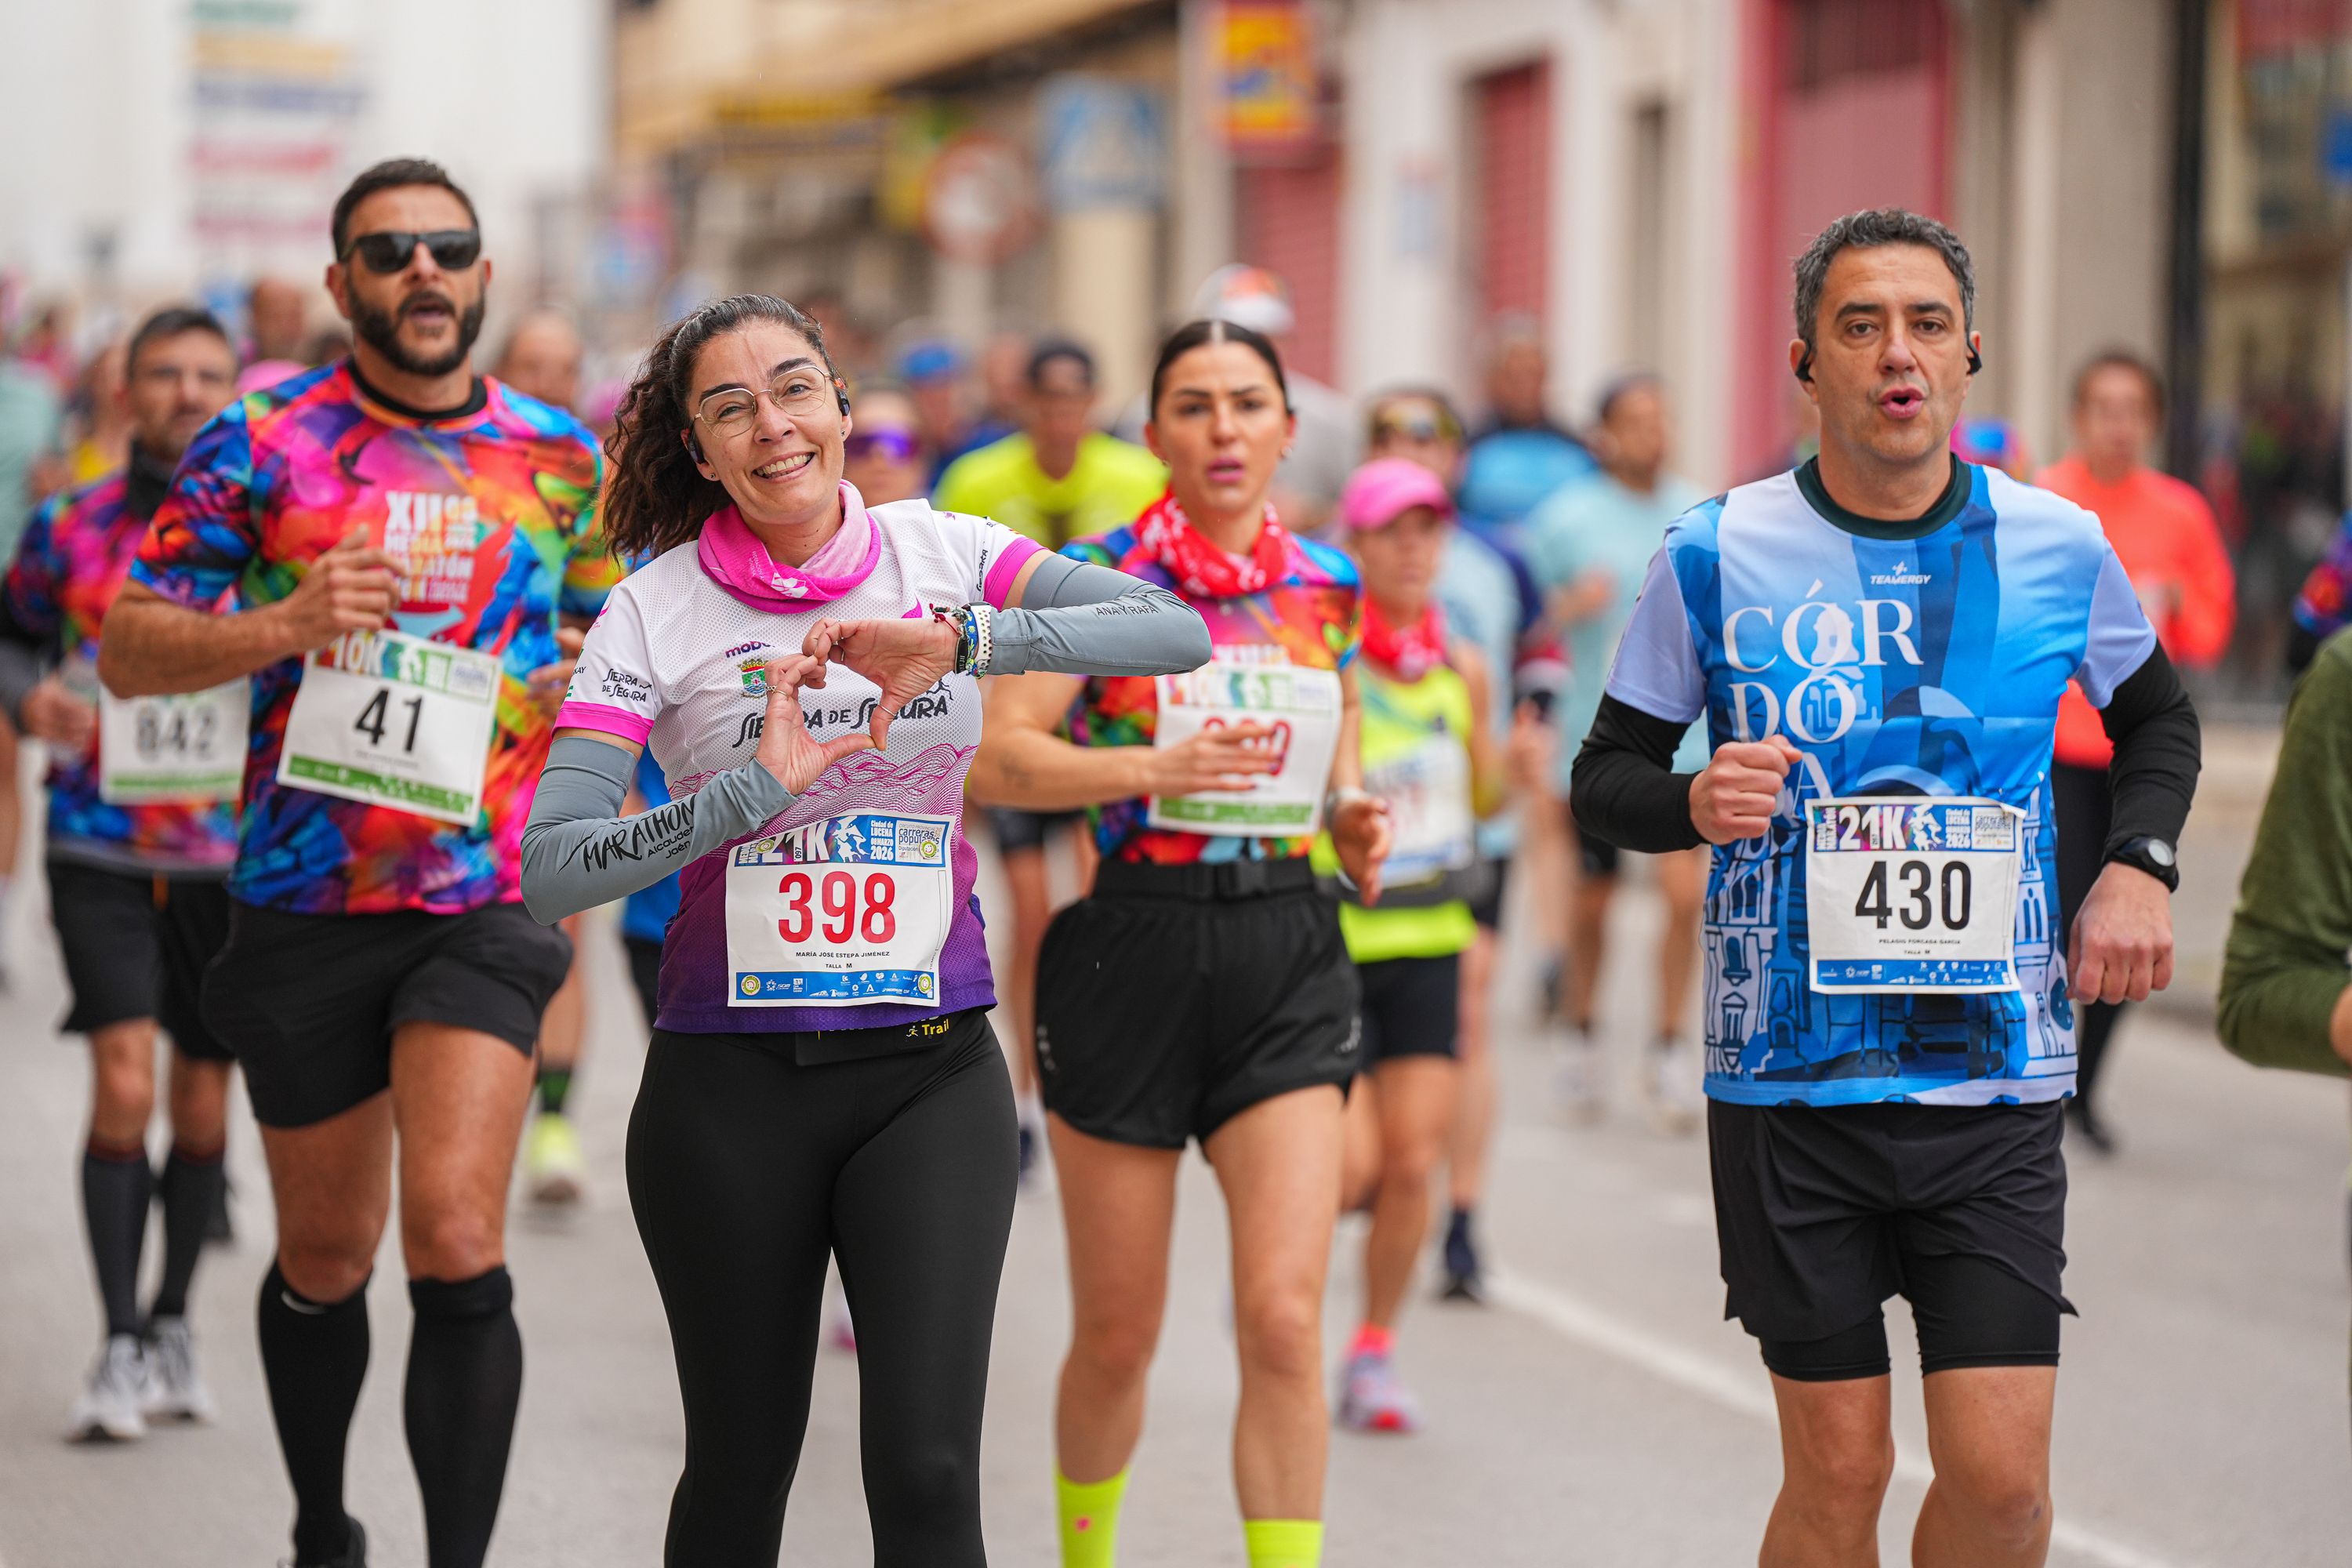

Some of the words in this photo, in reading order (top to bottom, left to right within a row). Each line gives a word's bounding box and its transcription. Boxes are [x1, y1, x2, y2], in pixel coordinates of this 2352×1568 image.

[1869, 575, 1932, 585] TEAMERGY
[1096, 607, 1120, 615] ANA
[1119, 605, 1127, 615] Y
[1127, 604, 1159, 615] RAFA
[603, 668, 638, 686] SIERRA
[609, 684, 647, 702] SEGURA
[354, 688, 425, 754] 41
[829, 709, 851, 724] DE
[851, 695, 949, 729] SEURA
[583, 793, 698, 872] MARATHON
[870, 827, 893, 837] LUCENA
[898, 828, 934, 837] carreras
[1838, 805, 1907, 851] 21K
[647, 826, 694, 858] Alcaudet
[665, 840, 691, 859] Jaén
[761, 818, 830, 862] 21K
[870, 846, 894, 861] 2026
[1855, 860, 1972, 931] 430
[778, 870, 896, 944] 398
[921, 1018, 949, 1036] Trail
